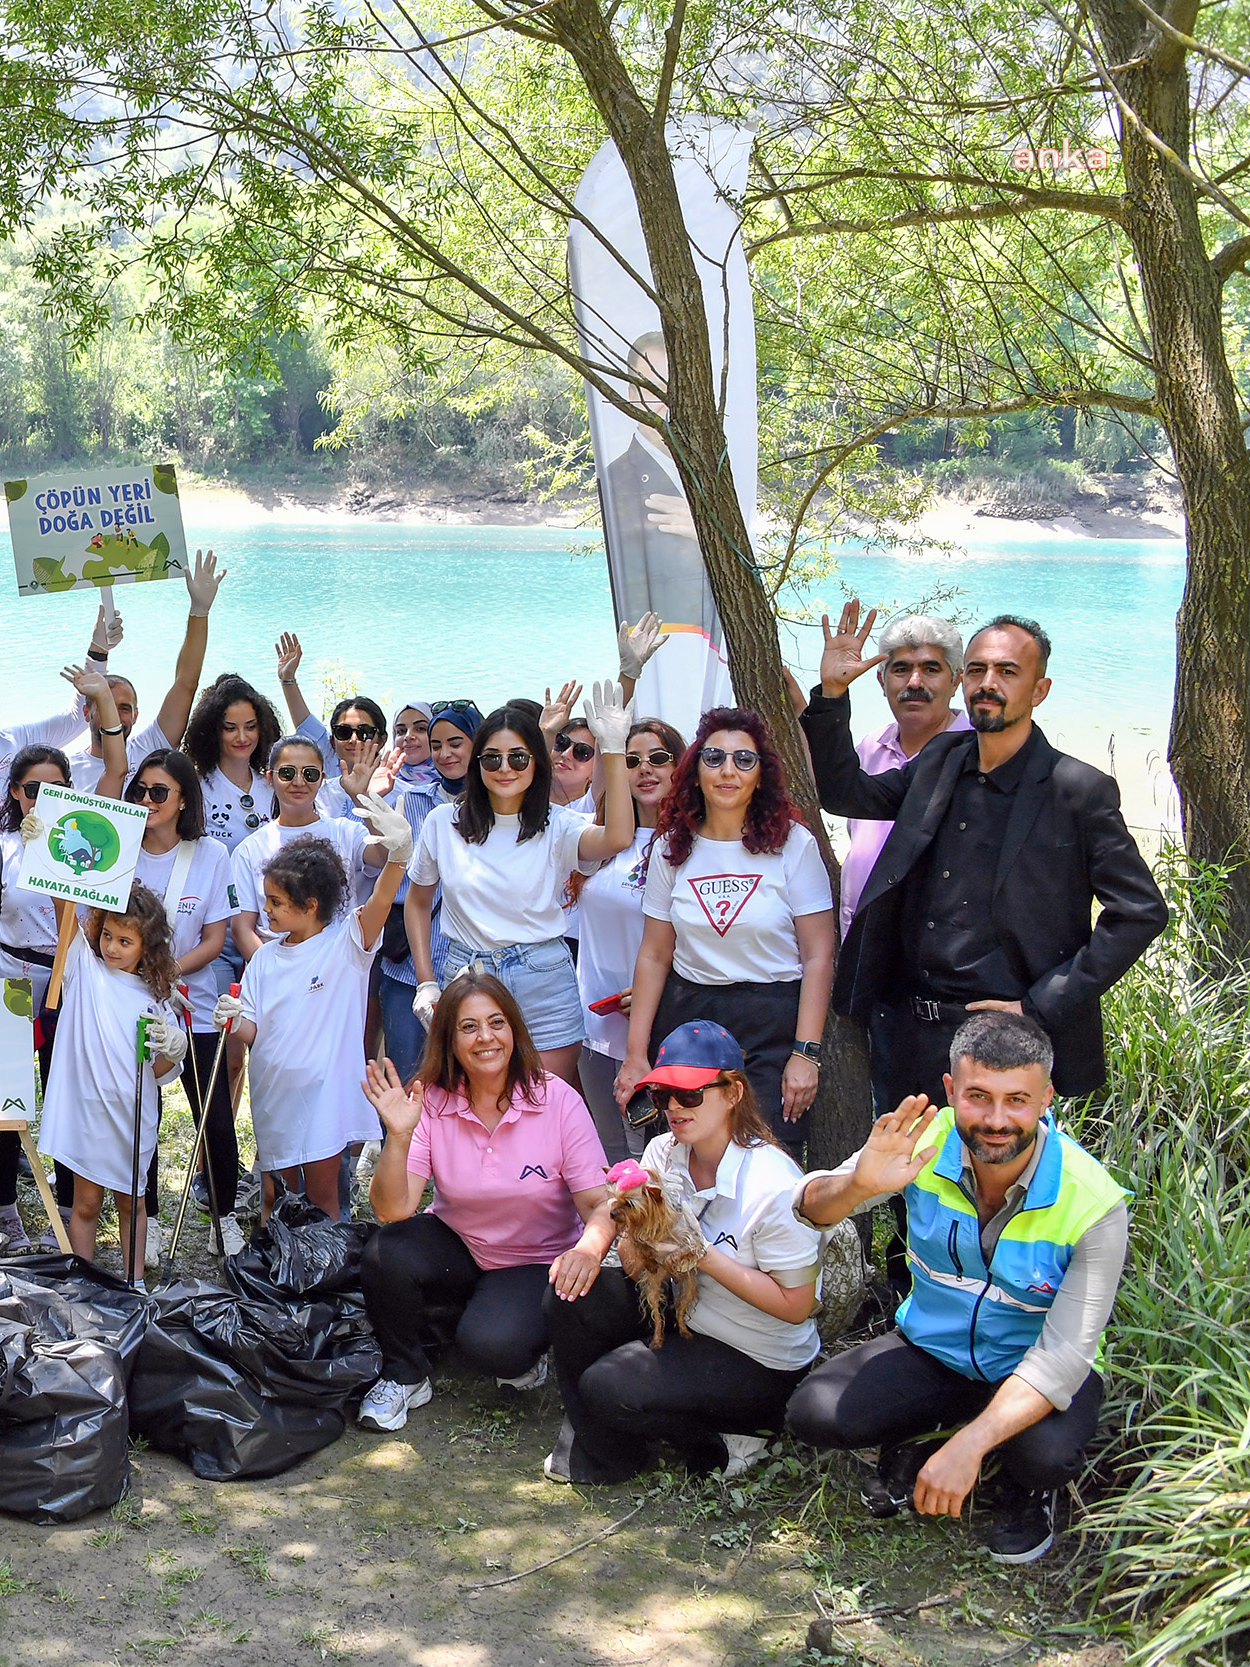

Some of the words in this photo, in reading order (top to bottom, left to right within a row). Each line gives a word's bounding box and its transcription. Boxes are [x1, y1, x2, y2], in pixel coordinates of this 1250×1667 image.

[35, 485, 101, 515] ÇÖPÜN
[108, 478, 151, 503] YERİ
[38, 509, 93, 535] DOĞA
[100, 502, 155, 528] DEĞİL
[42, 788, 63, 798] GERİ
[64, 793, 111, 810] DÖNÜŞTÜR
[112, 805, 147, 819] KULLAN
[210, 830, 233, 838] TUCK
[28, 876, 71, 894] HAYATA
[73, 887, 119, 906] BAĞLAN
[699, 879, 749, 896] GUESS
